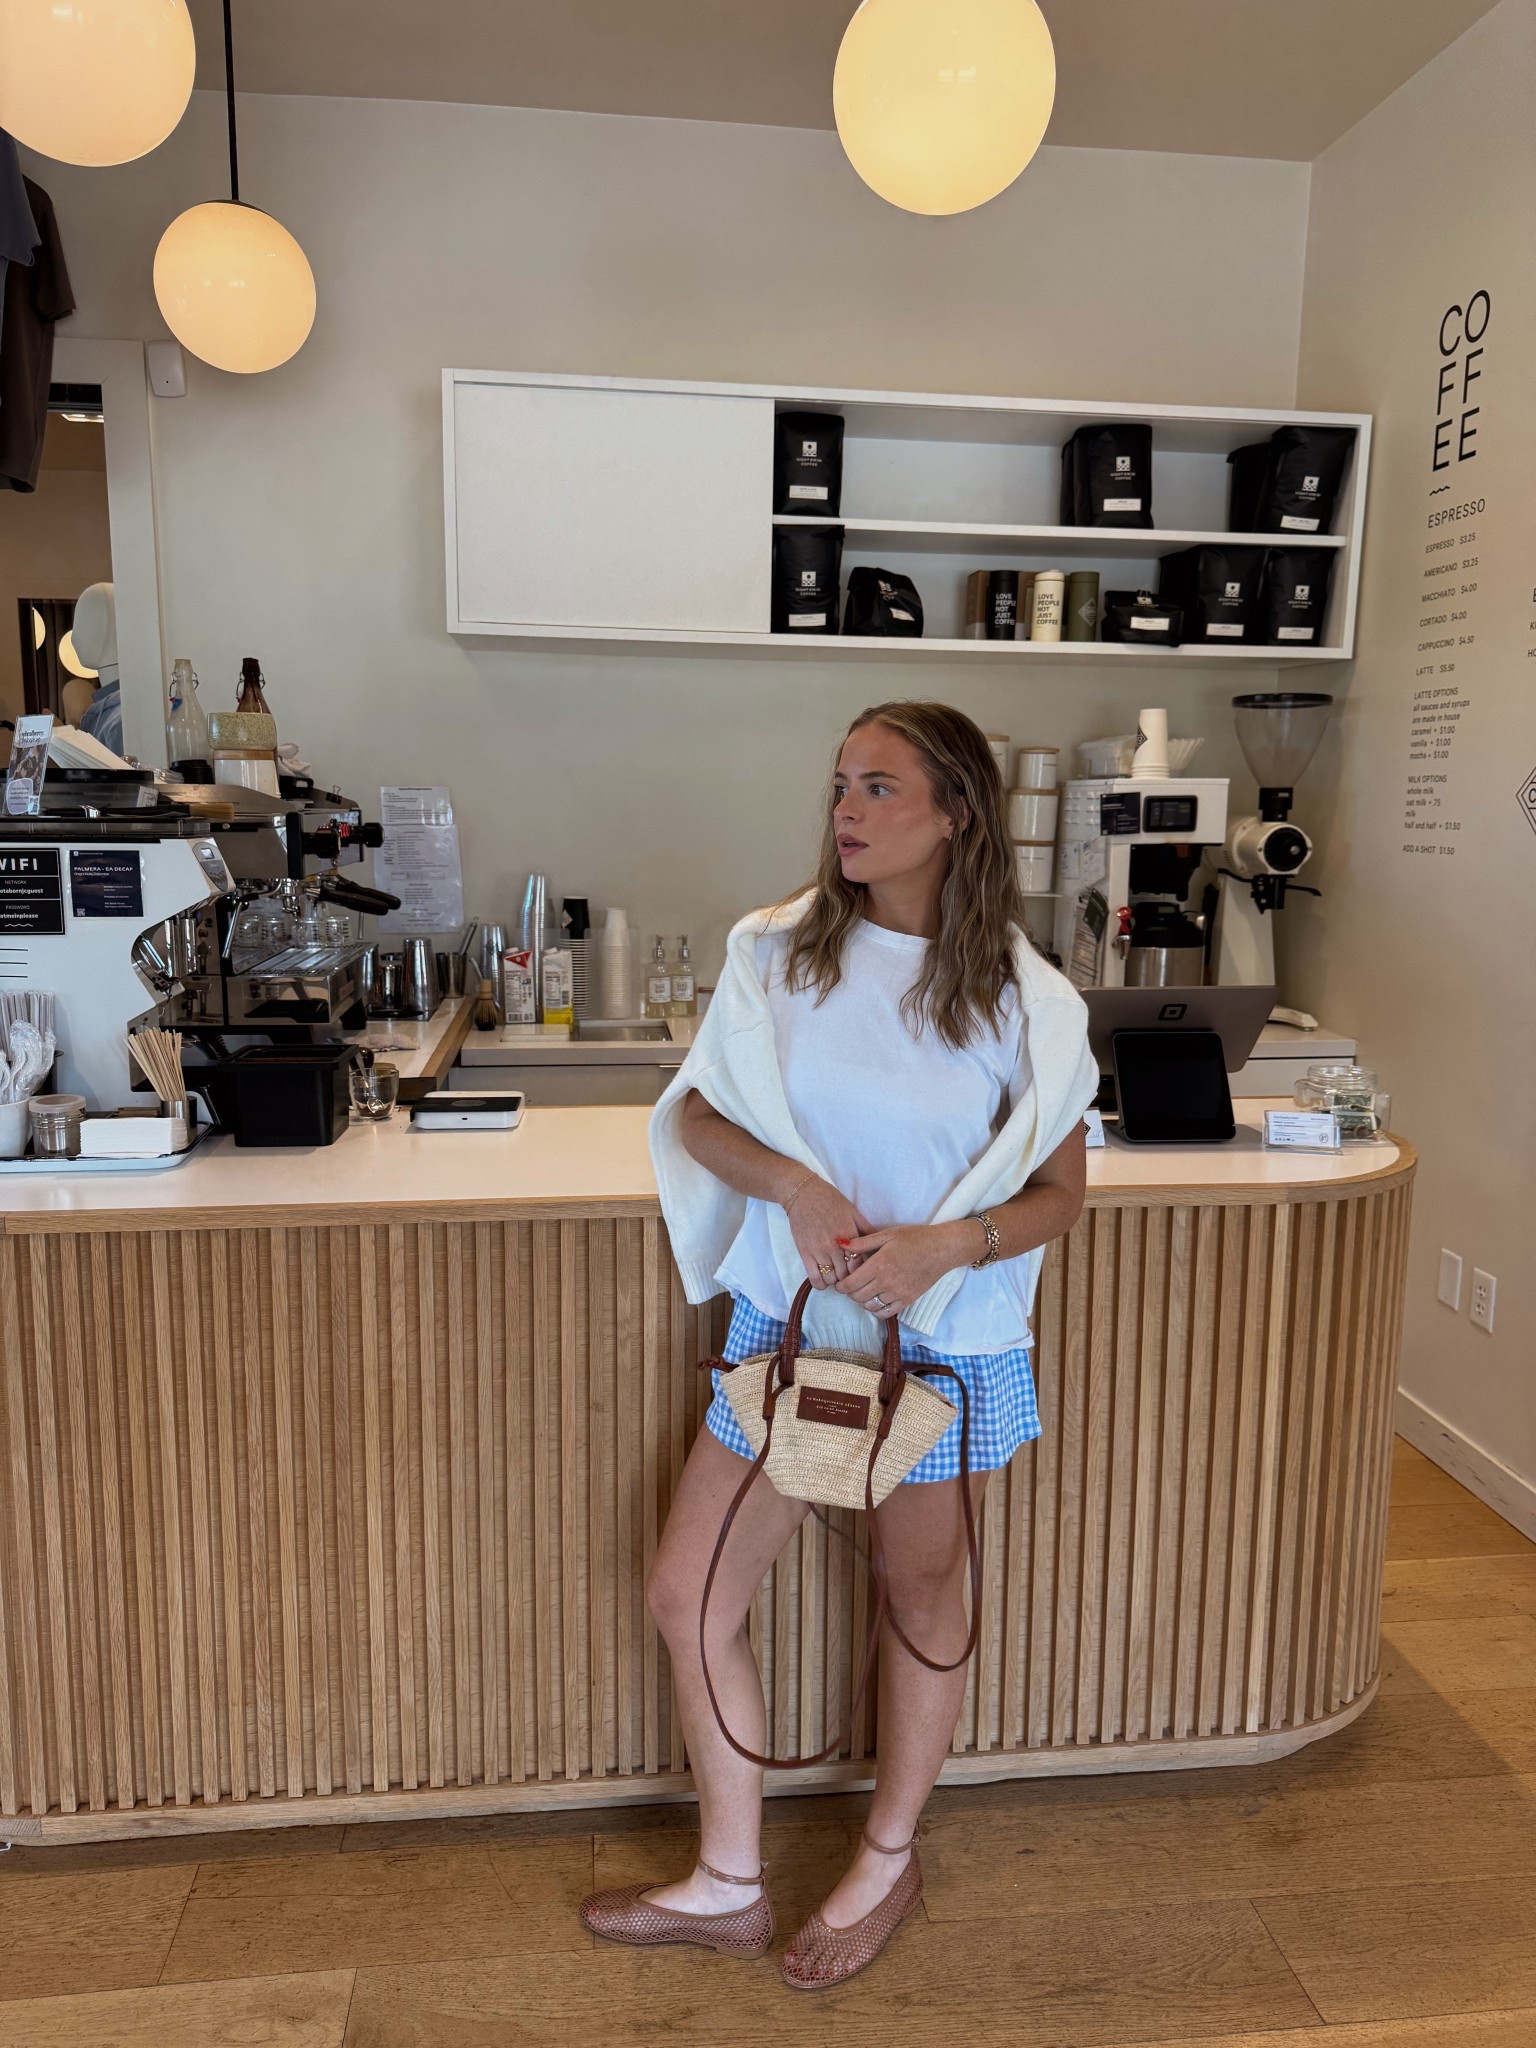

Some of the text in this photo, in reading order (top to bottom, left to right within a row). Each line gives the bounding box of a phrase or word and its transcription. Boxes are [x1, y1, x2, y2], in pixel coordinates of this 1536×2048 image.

[1428, 498, 1486, 528] ESPRESSO
[1425, 532, 1476, 554] ESPRESSO $3.25
[1424, 557, 1478, 577] AMERICANO $3.25
[1422, 588, 1456, 602] MACCHIATO
[1420, 614, 1447, 627] CORTADO
[1418, 638, 1454, 652] CAPPUCCINO
[1416, 666, 1434, 676] LATTE
[1414, 687, 1458, 700] LATTE OPTIONS
[1440, 700, 1450, 709] and
[1451, 700, 1470, 708] syrups
[1422, 714, 1436, 722] made
[1411, 726, 1432, 736] caramel
[1440, 726, 1455, 734] $1.00
[1436, 738, 1452, 746] $1.00
[1410, 752, 1426, 760] mocha
[1433, 750, 1449, 759] $1.00
[1422, 774, 1448, 783] OPTIONS
[1444, 822, 1460, 830] $1.50
[1402, 844, 1414, 852] ADD
[1420, 845, 1436, 854] SHOT
[1439, 846, 1455, 855] $1.50
